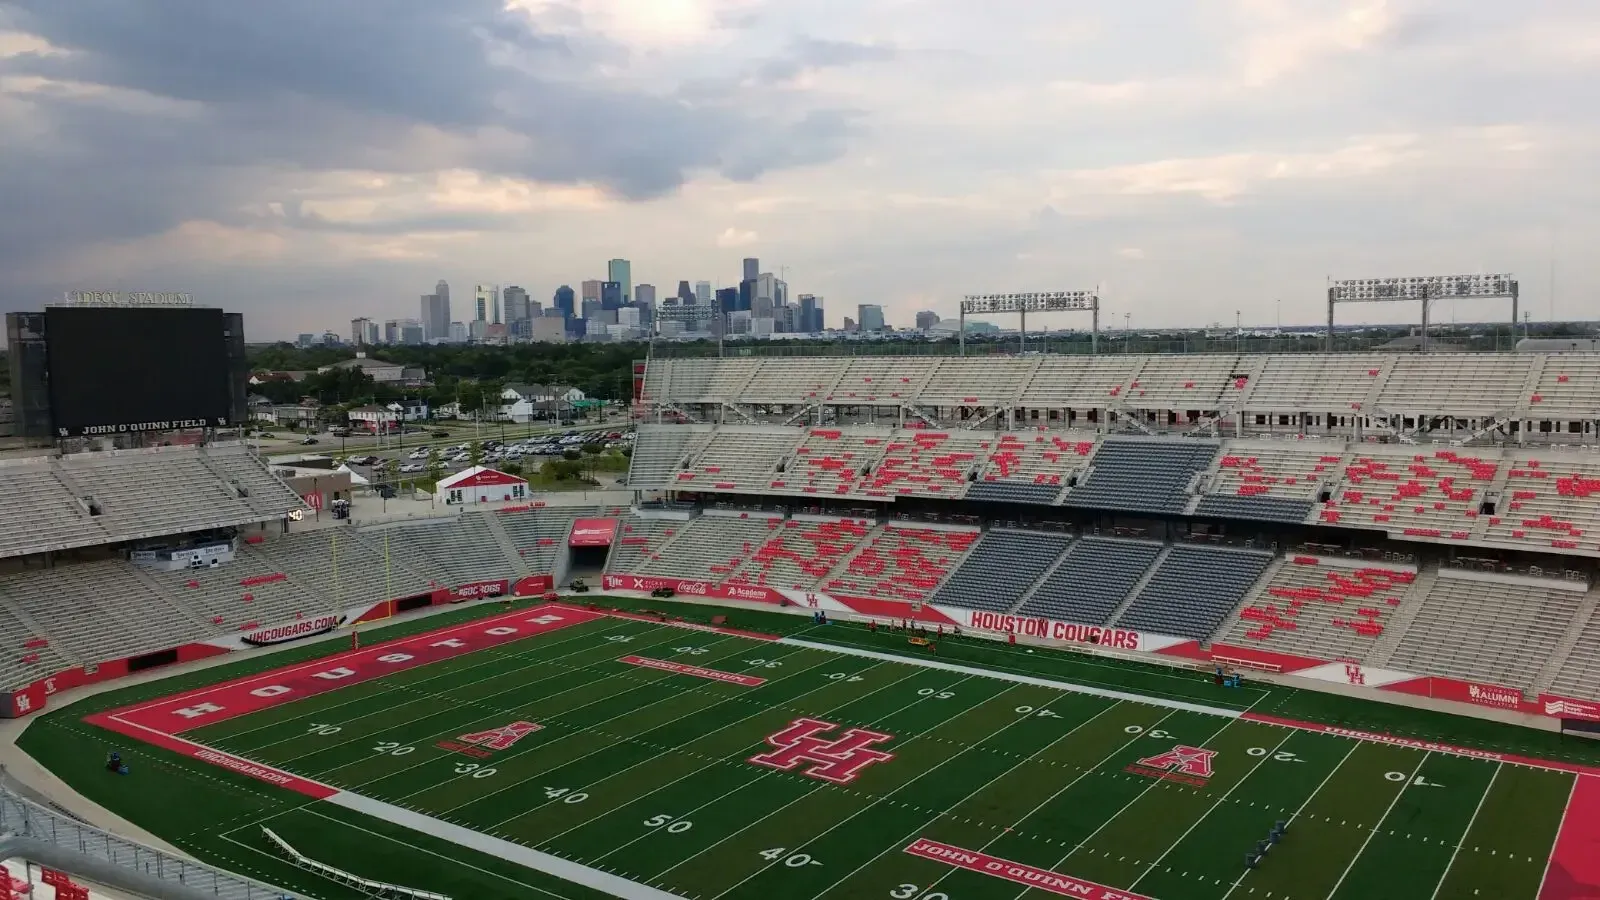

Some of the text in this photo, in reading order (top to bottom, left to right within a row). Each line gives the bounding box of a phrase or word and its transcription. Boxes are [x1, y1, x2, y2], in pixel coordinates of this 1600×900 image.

[128, 292, 194, 305] STADIUM
[82, 418, 206, 435] JOHN O'QUINN FIELD
[289, 509, 303, 521] 40
[249, 615, 338, 642] UHCOUGARS.COM
[971, 611, 1139, 650] HOUSTON COUGARS
[1480, 691, 1518, 705] ALUMNI
[372, 741, 416, 756] 20
[454, 763, 497, 778] 30
[544, 787, 589, 804] 40
[643, 814, 693, 834] 50
[757, 847, 812, 868] 40
[913, 844, 1094, 896] JOHN O'QUINN
